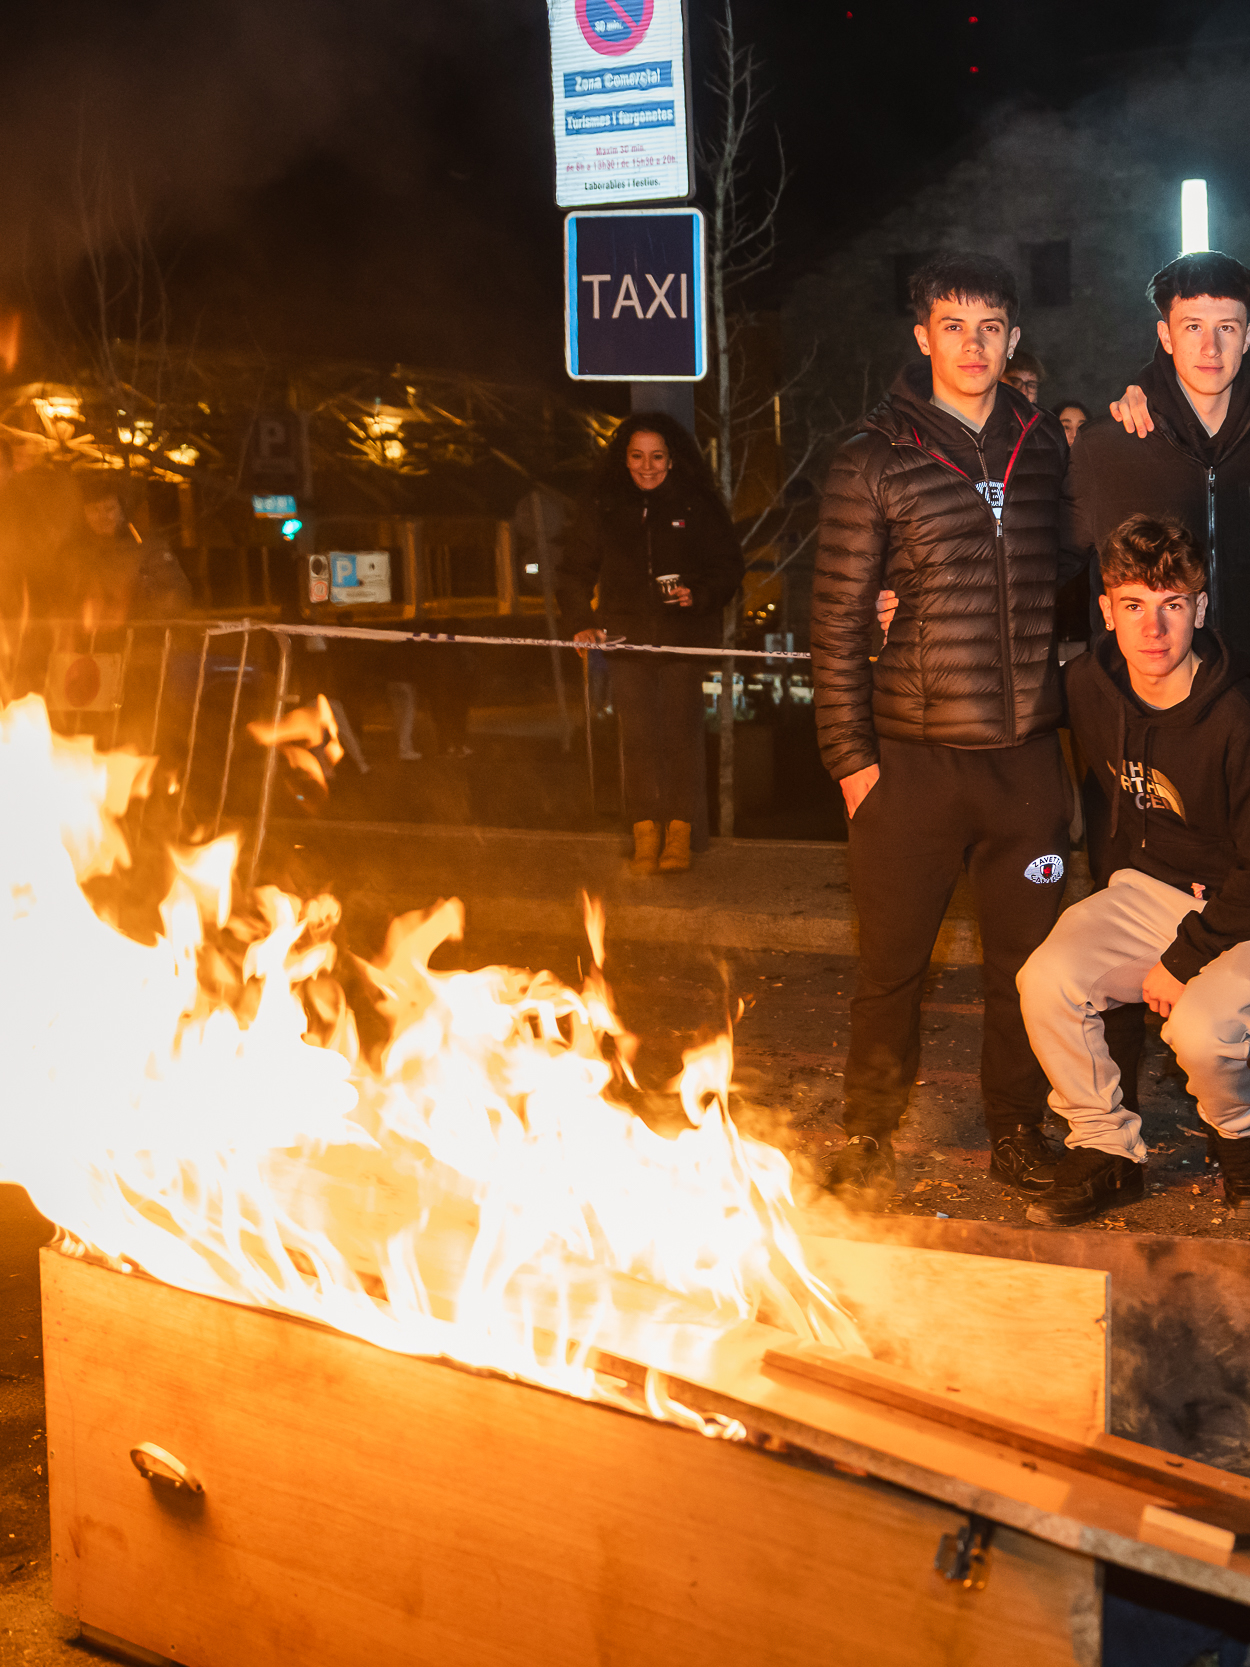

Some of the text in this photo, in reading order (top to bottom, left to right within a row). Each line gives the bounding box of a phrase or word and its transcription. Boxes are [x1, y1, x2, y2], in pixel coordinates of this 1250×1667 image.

[575, 68, 661, 92] Zona Comercial
[567, 114, 611, 130] Turismes
[618, 108, 674, 126] furgonetes
[584, 180, 625, 190] Laborables
[581, 273, 688, 320] TAXI
[336, 560, 353, 585] P
[1032, 856, 1061, 867] ZAVETTI
